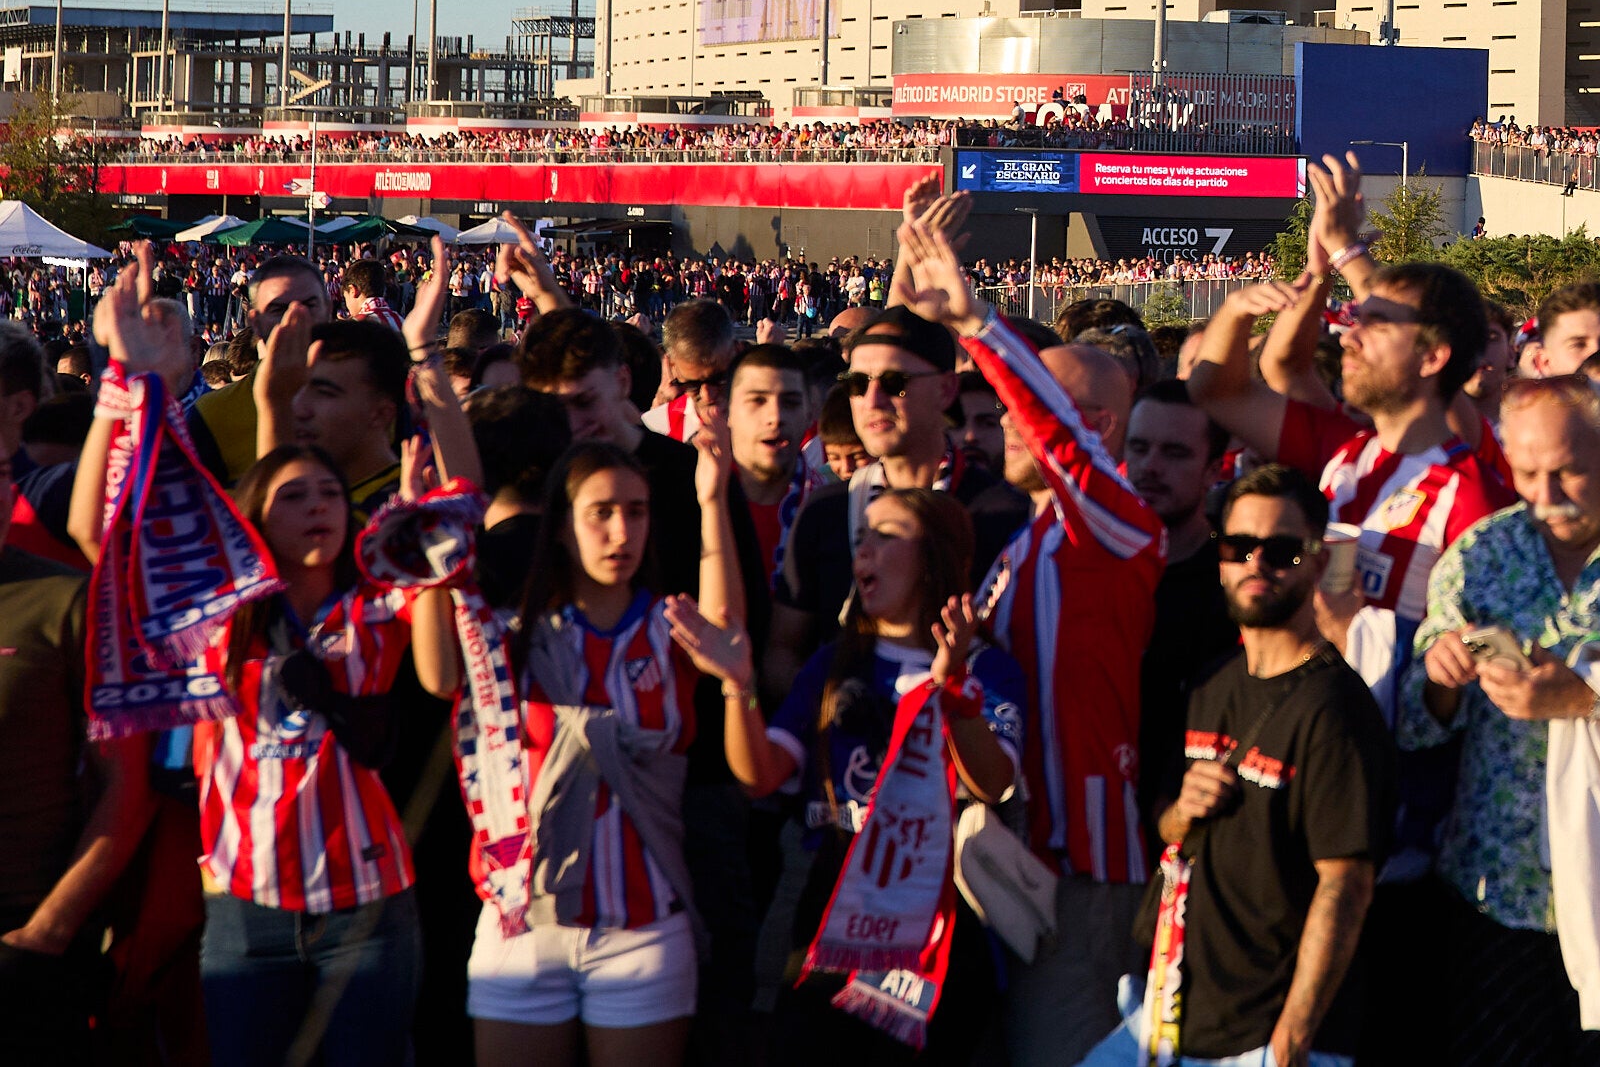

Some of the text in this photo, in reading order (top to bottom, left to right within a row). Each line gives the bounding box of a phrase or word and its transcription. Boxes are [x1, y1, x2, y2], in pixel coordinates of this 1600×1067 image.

[895, 84, 1048, 103] ATLÉTICO DE MADRID STORE
[996, 171, 1060, 180] ESCENARIO
[1004, 163, 1053, 172] EL GRAN
[1095, 163, 1248, 177] Reserva tu mesa y vive actuaciones
[375, 168, 401, 191] ATLÉTICO
[407, 172, 431, 191] MADRID
[1094, 176, 1228, 189] y conciertos los días de partido
[1142, 228, 1233, 261] ACCESO 7
[92, 675, 222, 707] 2016
